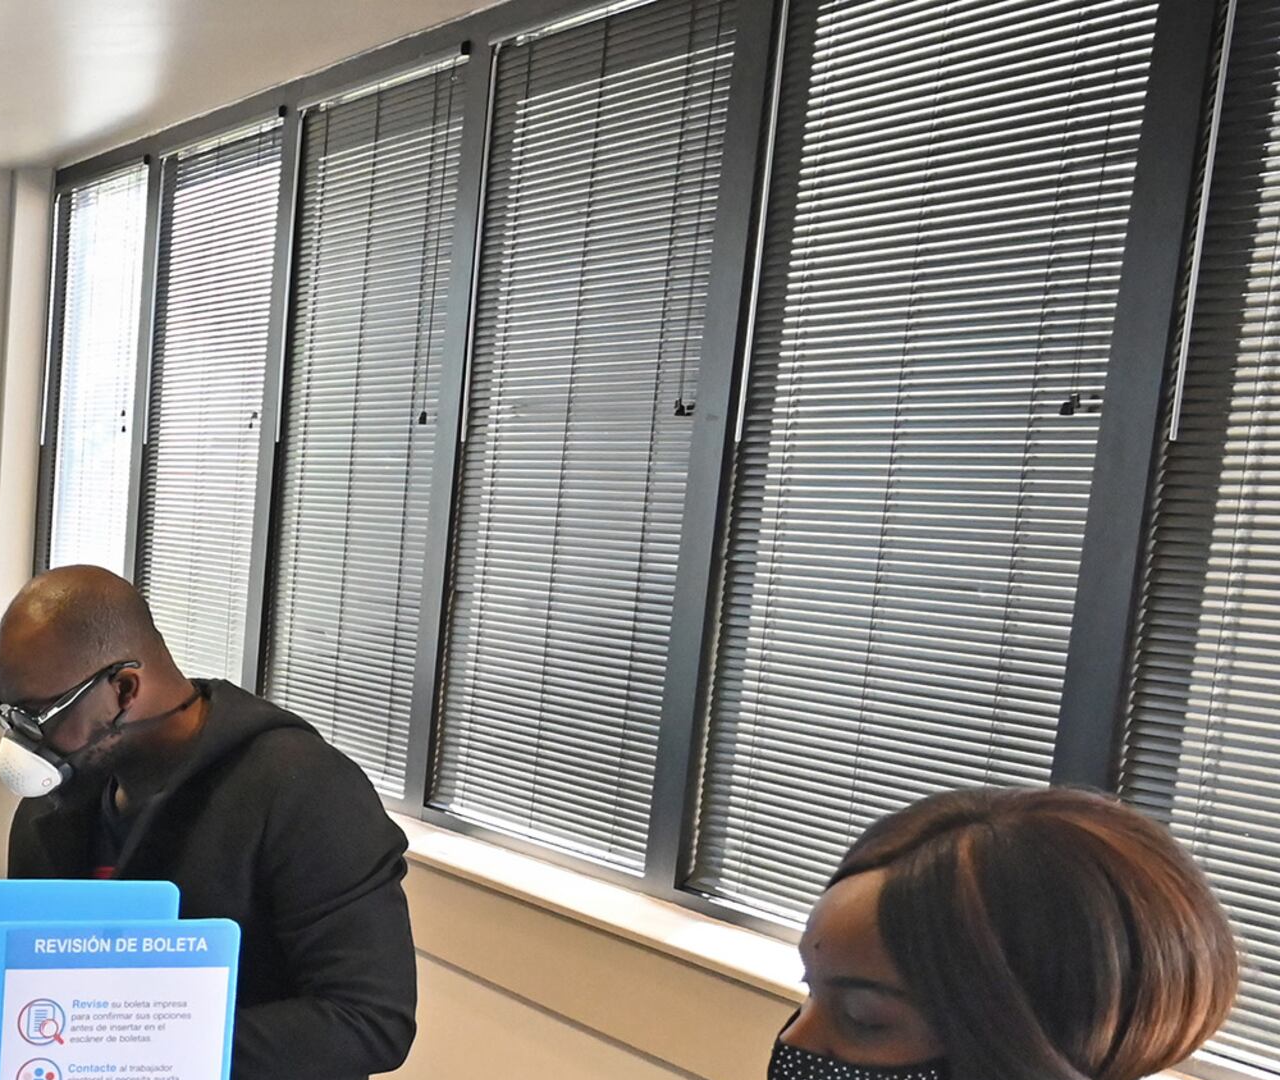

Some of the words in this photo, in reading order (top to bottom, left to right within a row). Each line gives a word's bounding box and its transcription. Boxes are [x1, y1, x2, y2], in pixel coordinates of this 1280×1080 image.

[34, 936, 112, 954] REVISIÓN
[115, 938, 137, 952] DE
[142, 937, 208, 952] BOLETA
[72, 1000, 109, 1008] Revise
[124, 1000, 150, 1008] boleta
[153, 1000, 187, 1010] impresa
[92, 1012, 133, 1020] confirmar
[70, 1024, 93, 1032] antes
[68, 1064, 116, 1073] Contacte
[129, 1064, 173, 1074] trabajador
